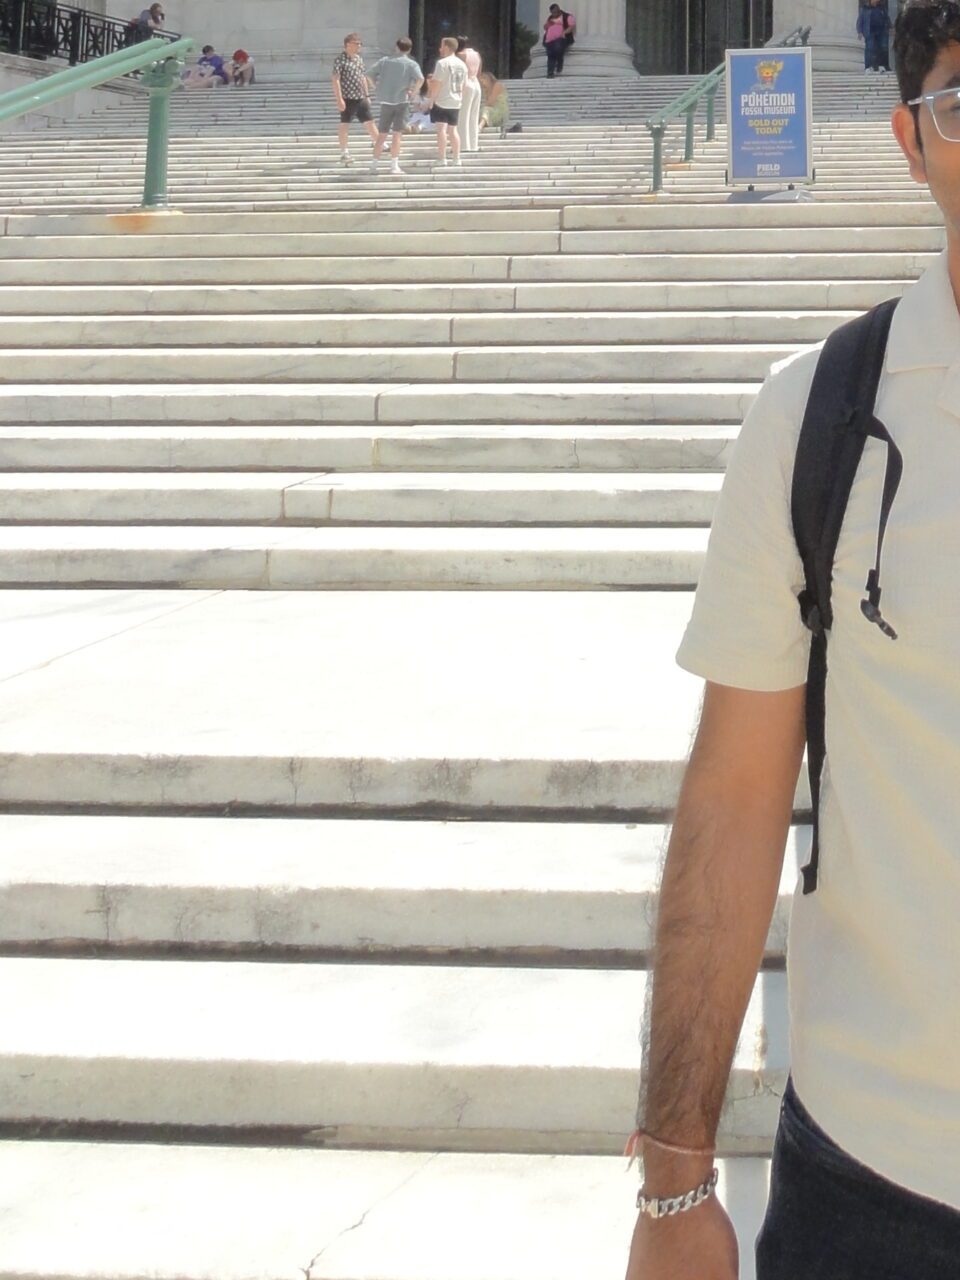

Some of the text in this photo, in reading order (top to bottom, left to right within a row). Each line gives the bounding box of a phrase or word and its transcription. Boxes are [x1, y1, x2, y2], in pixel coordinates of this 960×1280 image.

[741, 92, 795, 106] POKÉMON
[741, 106, 795, 116] FOSSIL MUSEUM
[748, 119, 789, 127] SOLD OUT
[755, 127, 783, 135] TODAY
